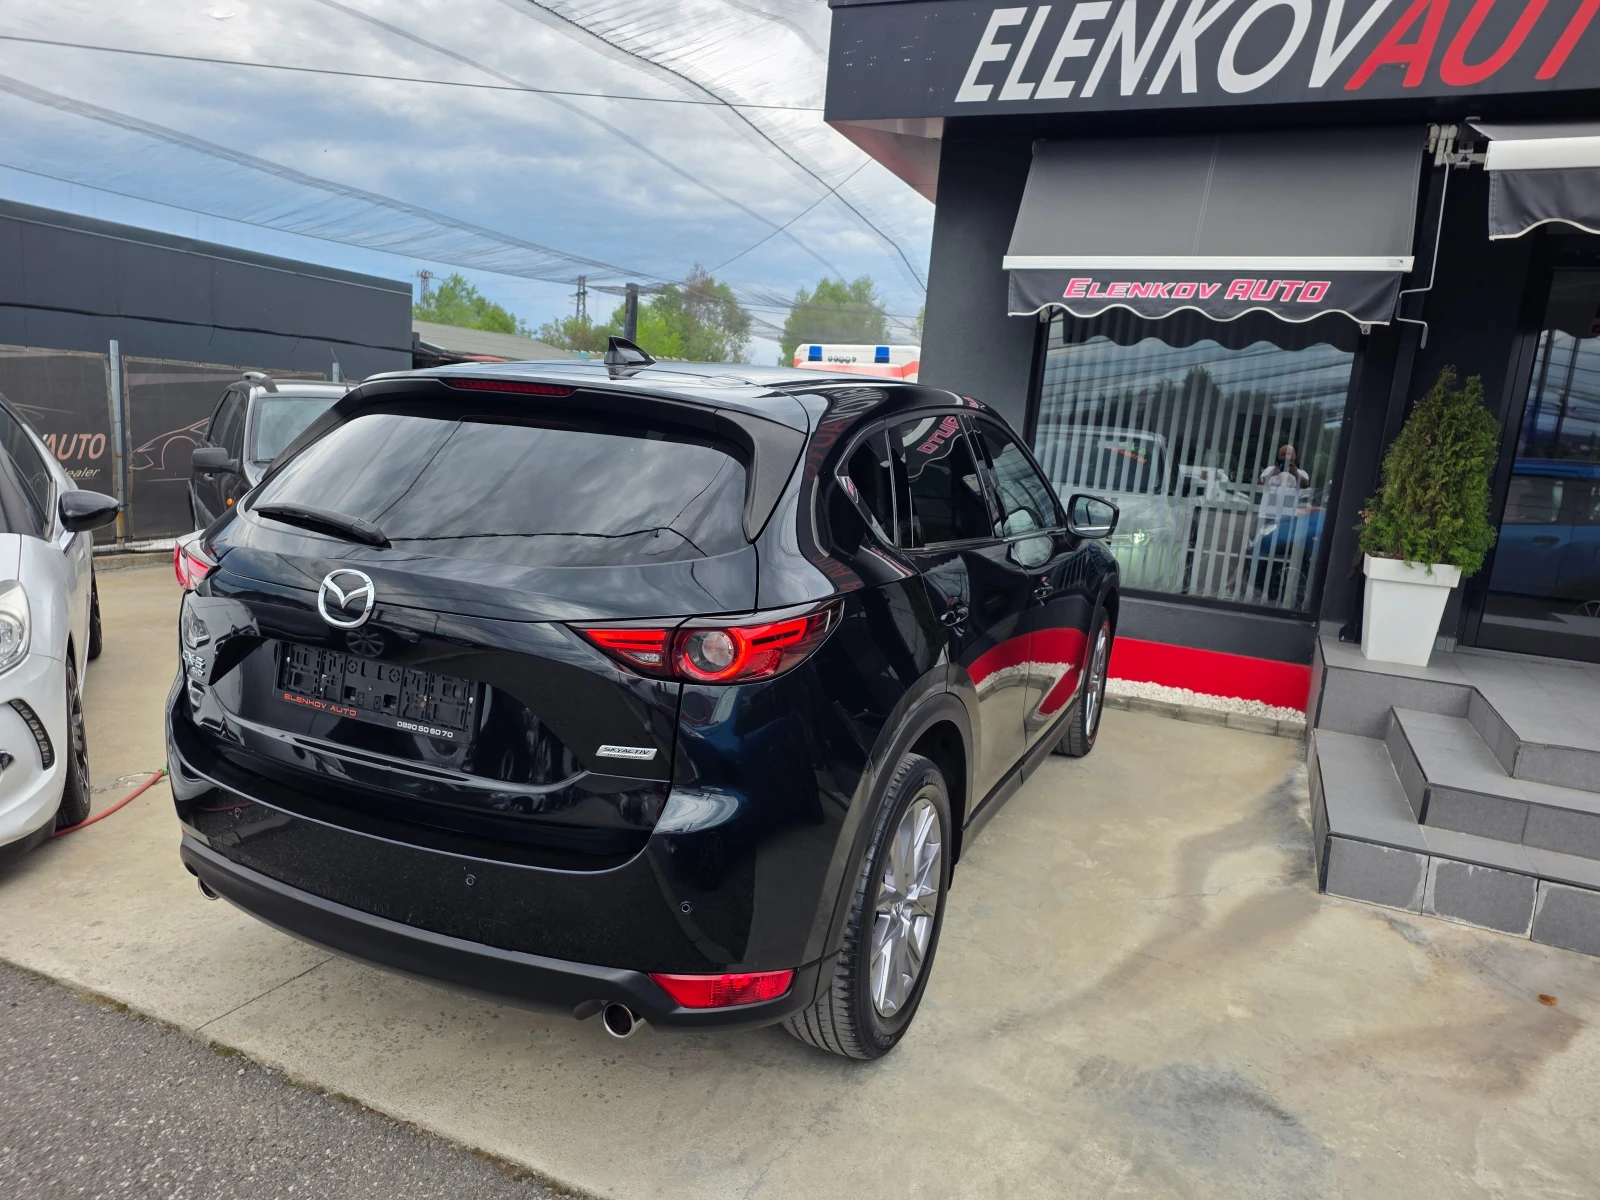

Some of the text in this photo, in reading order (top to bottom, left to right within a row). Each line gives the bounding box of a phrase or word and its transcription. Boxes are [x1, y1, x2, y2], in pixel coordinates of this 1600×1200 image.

[1063, 277, 1331, 302] ELENKOV AUTO
[65, 466, 101, 478] ealer
[284, 693, 357, 717] ELENKOV AUTO
[442, 730, 454, 738] 70
[604, 747, 650, 755] SKYACTIV
